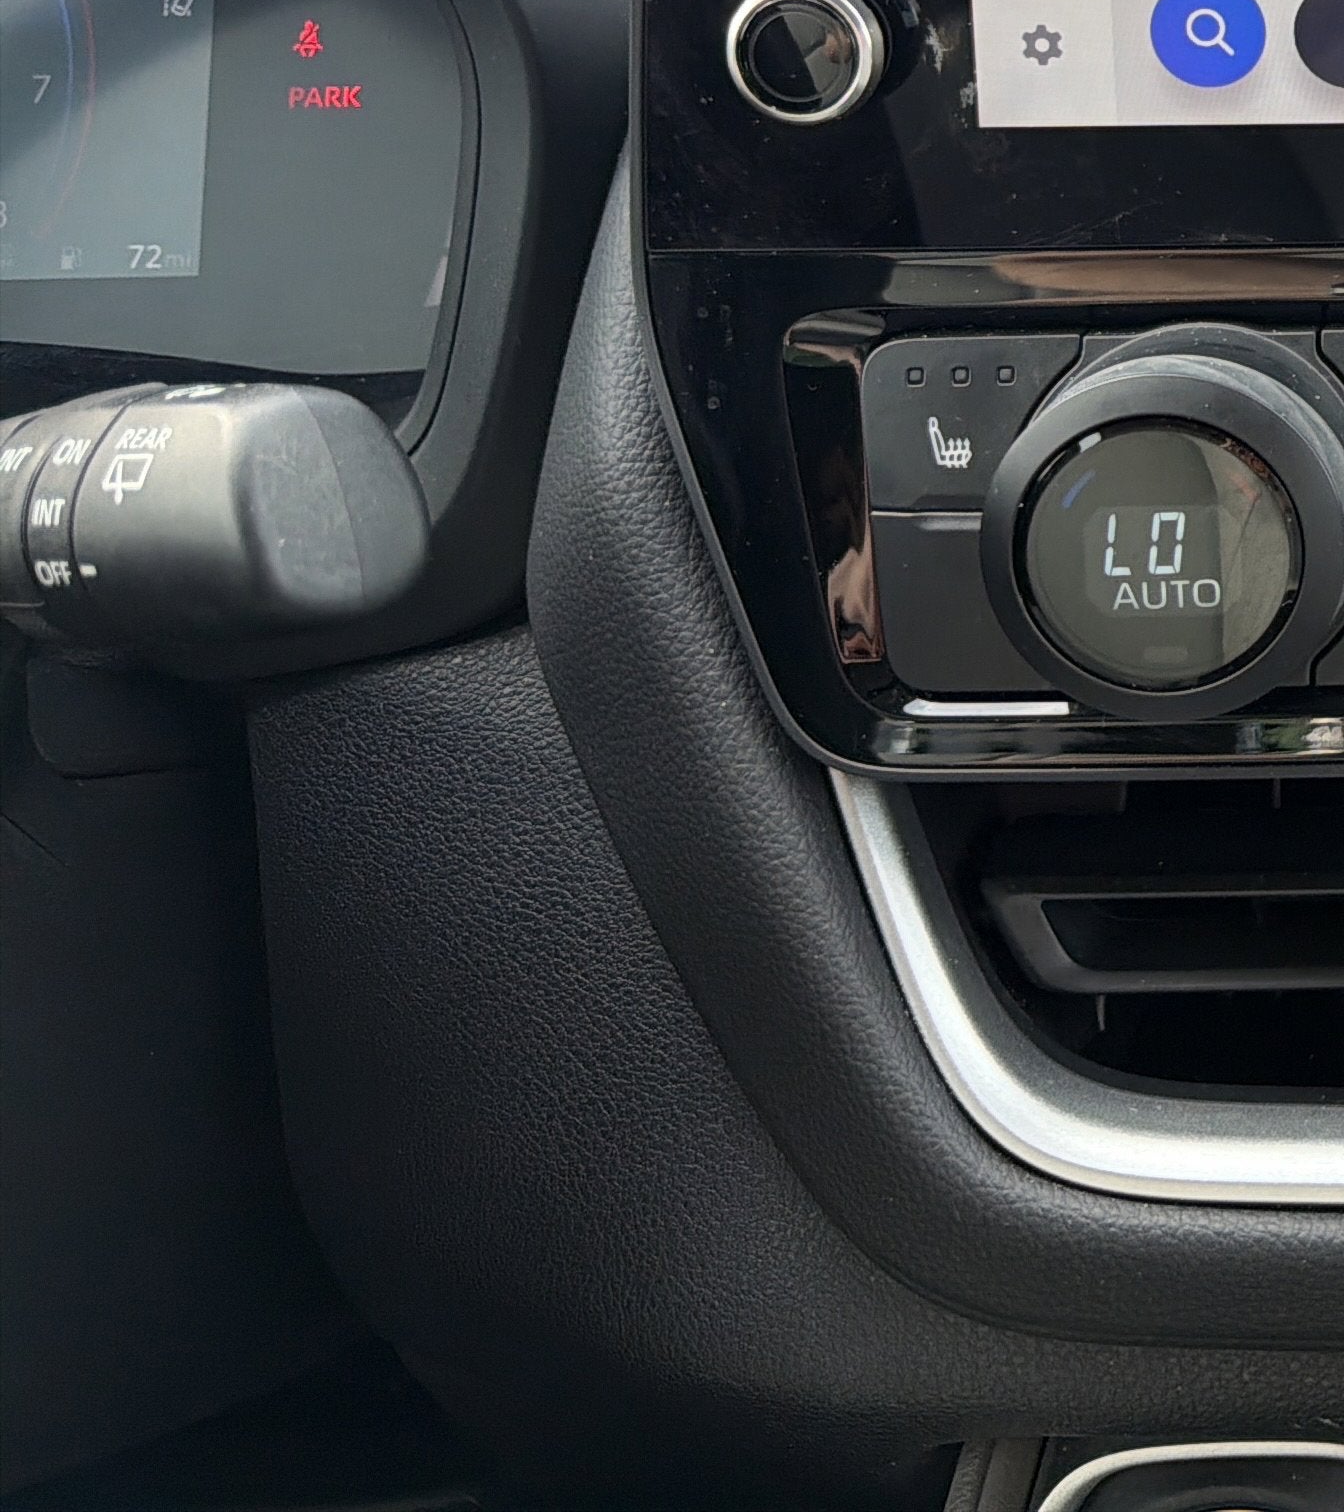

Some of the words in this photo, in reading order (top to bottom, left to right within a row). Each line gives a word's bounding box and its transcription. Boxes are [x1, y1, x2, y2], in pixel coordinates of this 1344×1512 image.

[32, 75, 51, 104] 7
[288, 85, 362, 109] PARK
[127, 244, 162, 269] 72
[52, 439, 91, 464] ON
[114, 427, 172, 450] REAR
[31, 498, 66, 526] INT
[34, 560, 72, 587] OFF
[1113, 578, 1222, 610] AUTO
